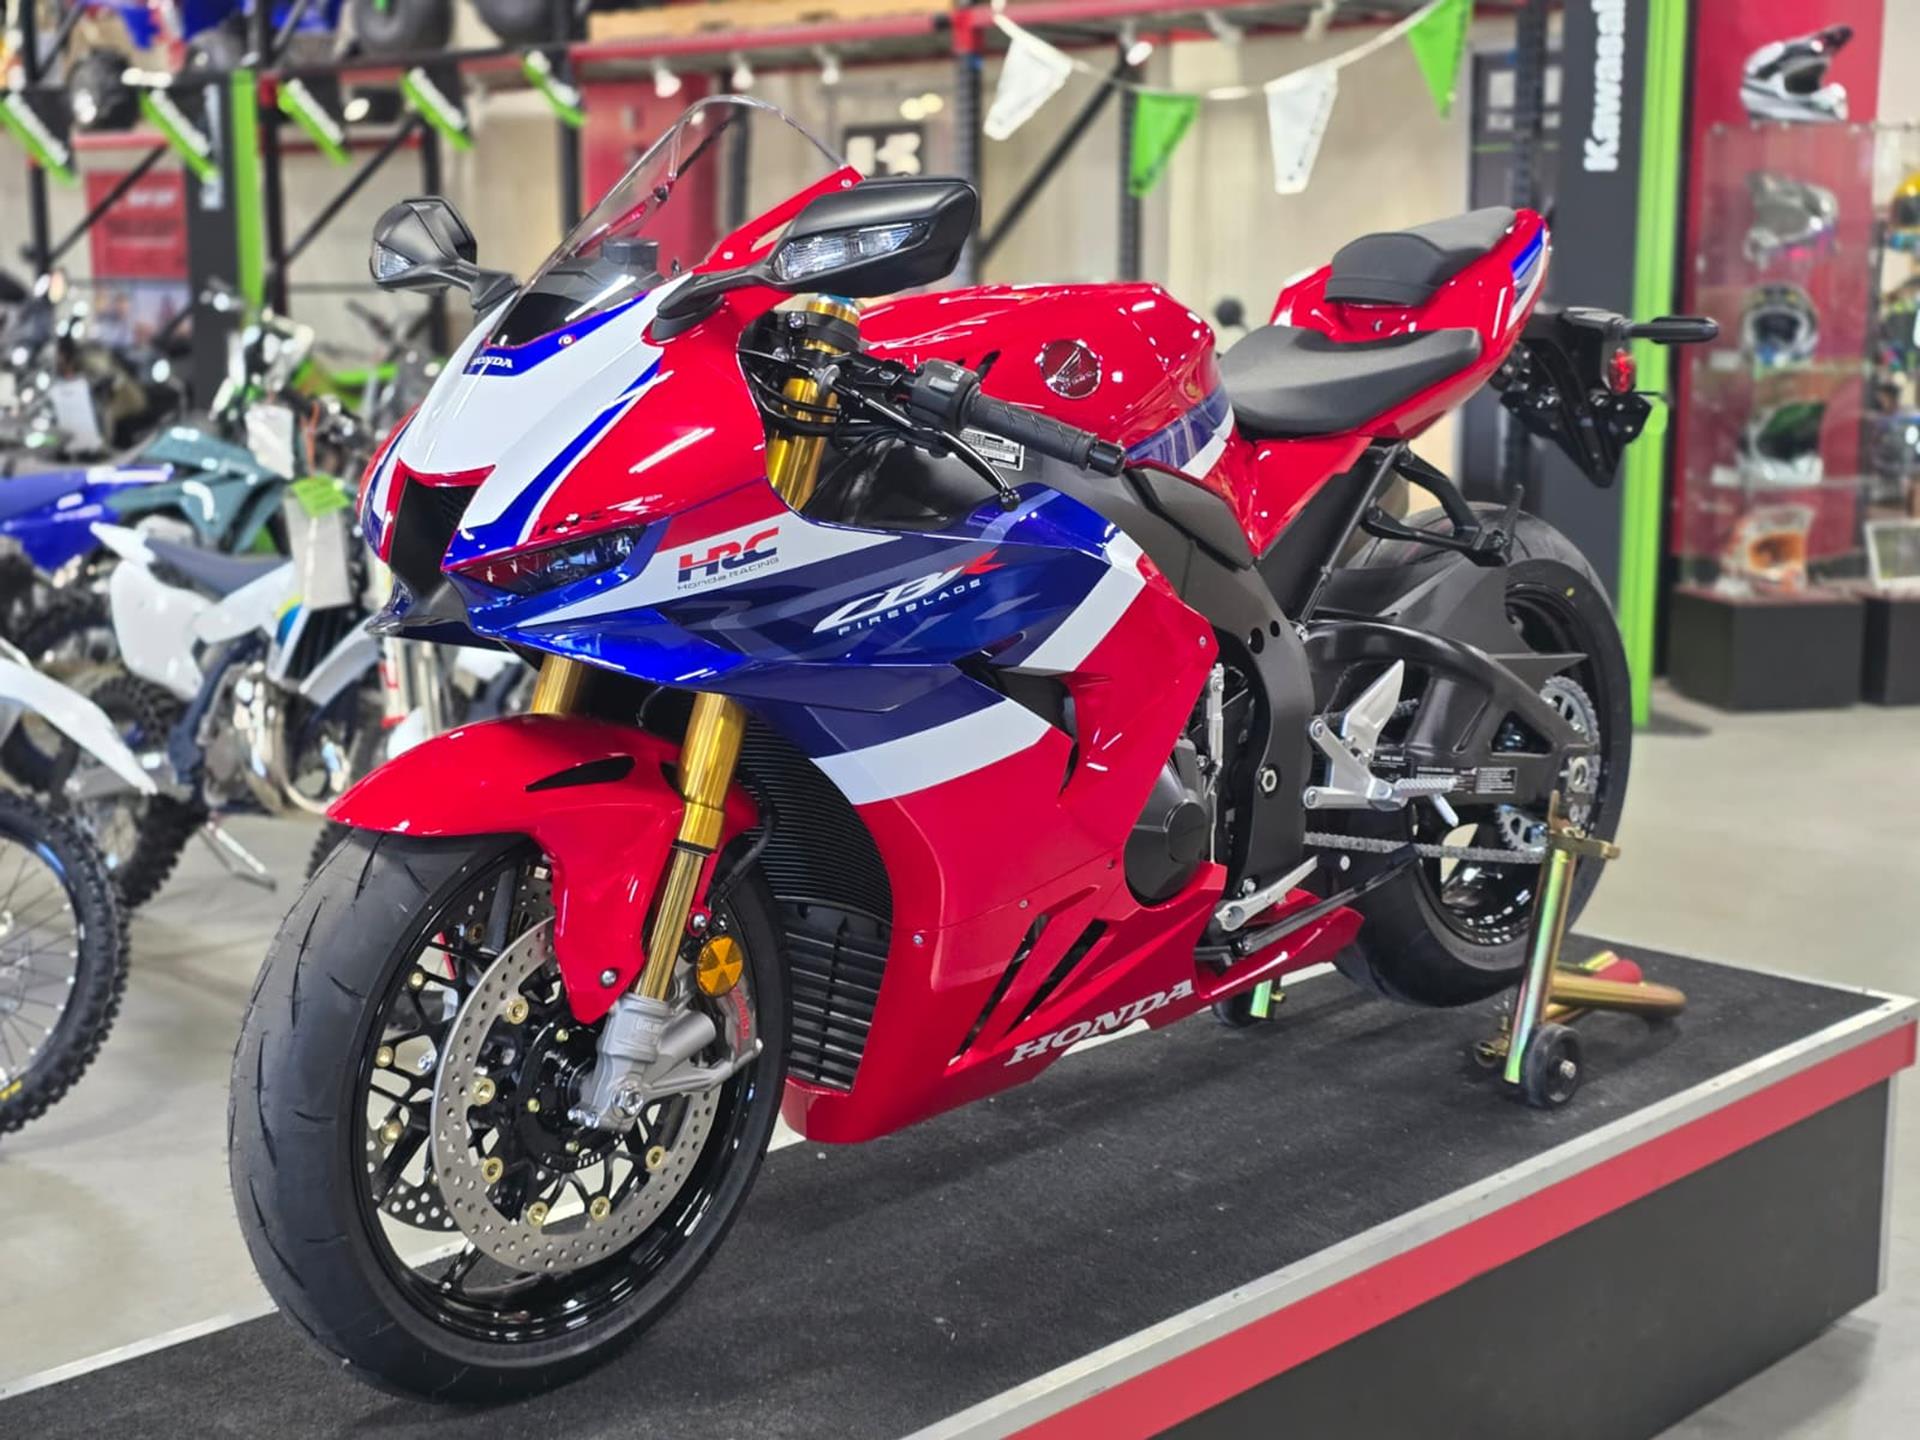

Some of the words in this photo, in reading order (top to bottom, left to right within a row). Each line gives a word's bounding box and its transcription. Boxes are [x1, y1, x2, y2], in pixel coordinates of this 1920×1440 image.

[678, 526, 780, 583] HRC
[728, 557, 779, 578] RACING
[838, 578, 981, 636] FIREBLADE
[1003, 979, 1195, 1066] HONDA
